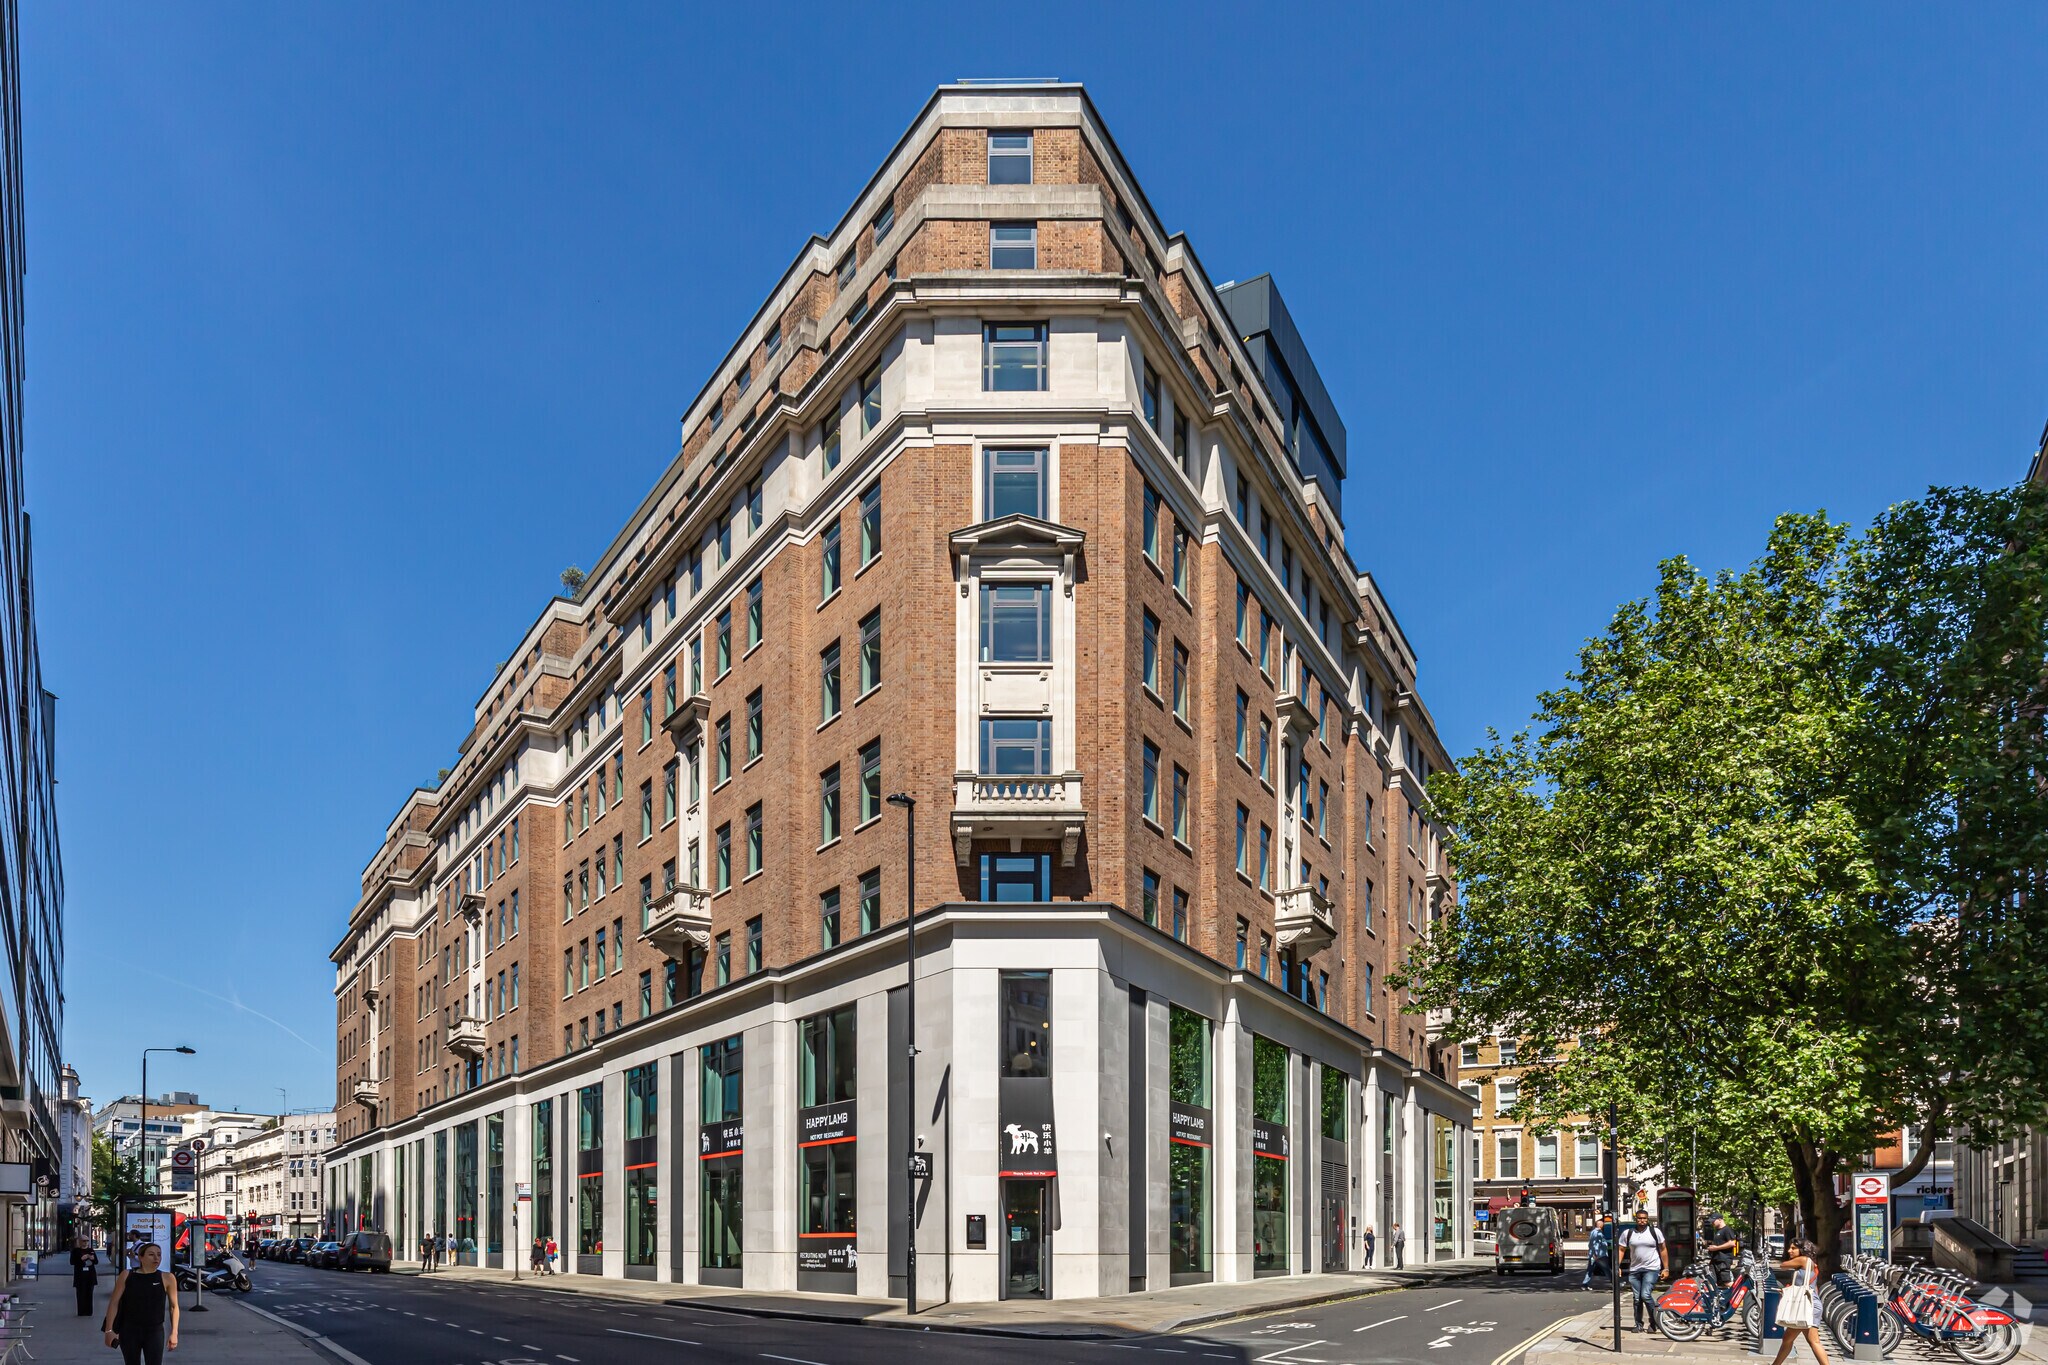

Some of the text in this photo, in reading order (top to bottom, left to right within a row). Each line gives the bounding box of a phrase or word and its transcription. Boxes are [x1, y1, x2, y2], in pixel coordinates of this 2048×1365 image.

[806, 1113, 848, 1129] HAPPY LAMB
[1173, 1112, 1204, 1129] HAPPY LAMB
[824, 1131, 844, 1139] RESTAURANT
[1042, 1123, 1052, 1155] 快乐小羊
[196, 1141, 201, 1149] R
